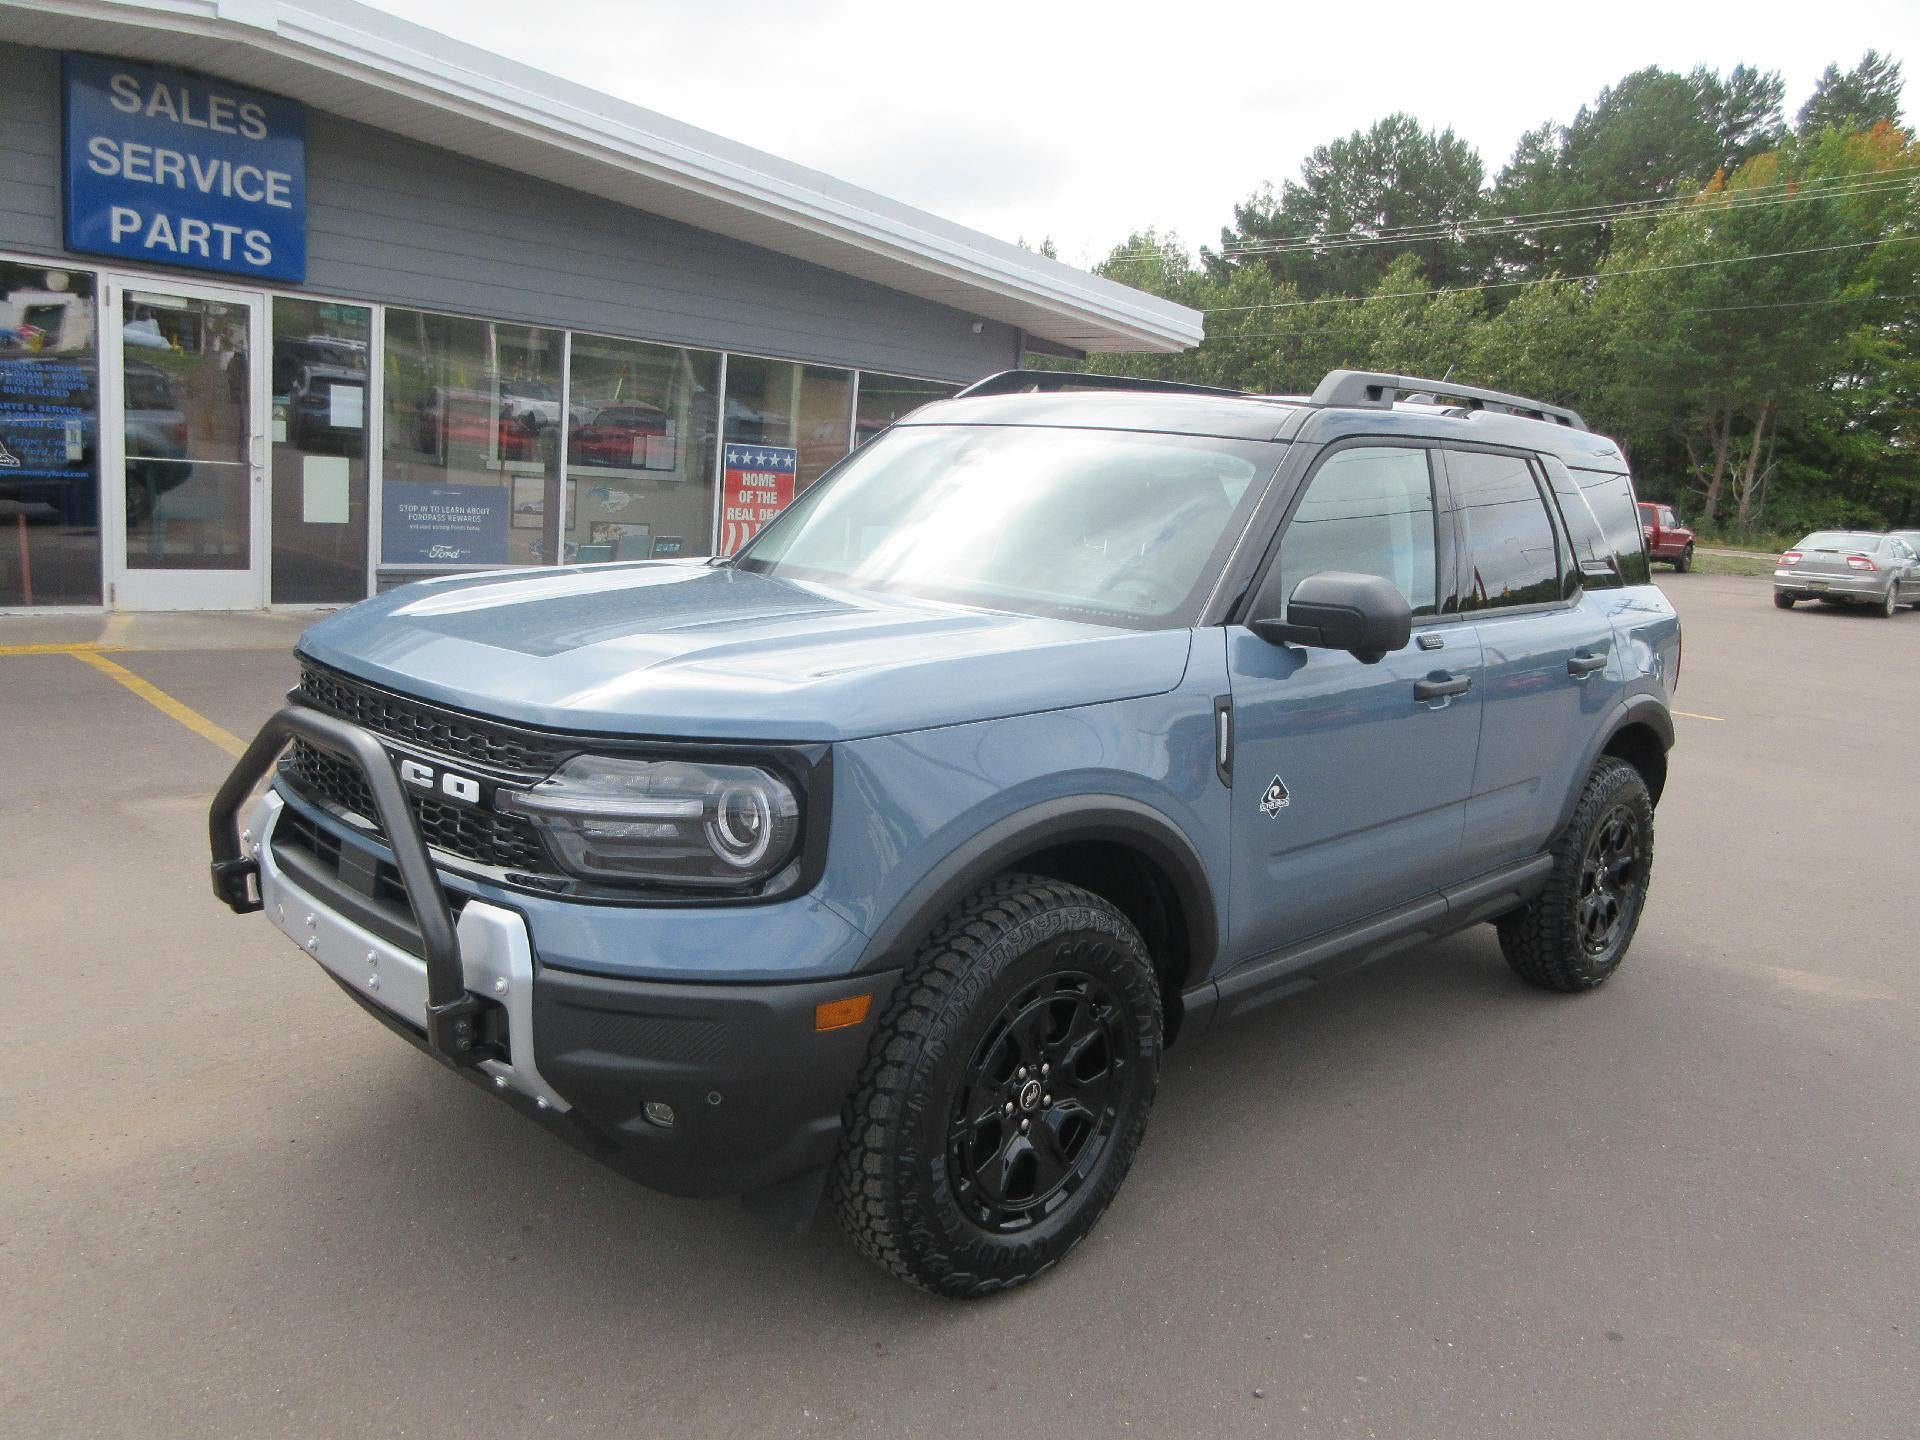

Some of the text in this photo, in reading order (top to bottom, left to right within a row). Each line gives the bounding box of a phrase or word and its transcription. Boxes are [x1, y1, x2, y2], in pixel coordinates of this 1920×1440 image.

[110, 74, 267, 140] SALES
[88, 136, 292, 209] SERVICE
[111, 205, 272, 266] PARTS
[0, 402, 25, 411] ARTS
[38, 405, 82, 415] SERVICE
[742, 472, 776, 487] HOME
[738, 490, 778, 504] OF THE
[399, 504, 418, 512] STOP
[441, 506, 465, 514] LEARN
[467, 507, 490, 515] ABOUT
[727, 507, 755, 520] REAL
[408, 513, 481, 523] FORDPASS REWARDS
[429, 544, 461, 559] Ford
[401, 759, 480, 803] CO
